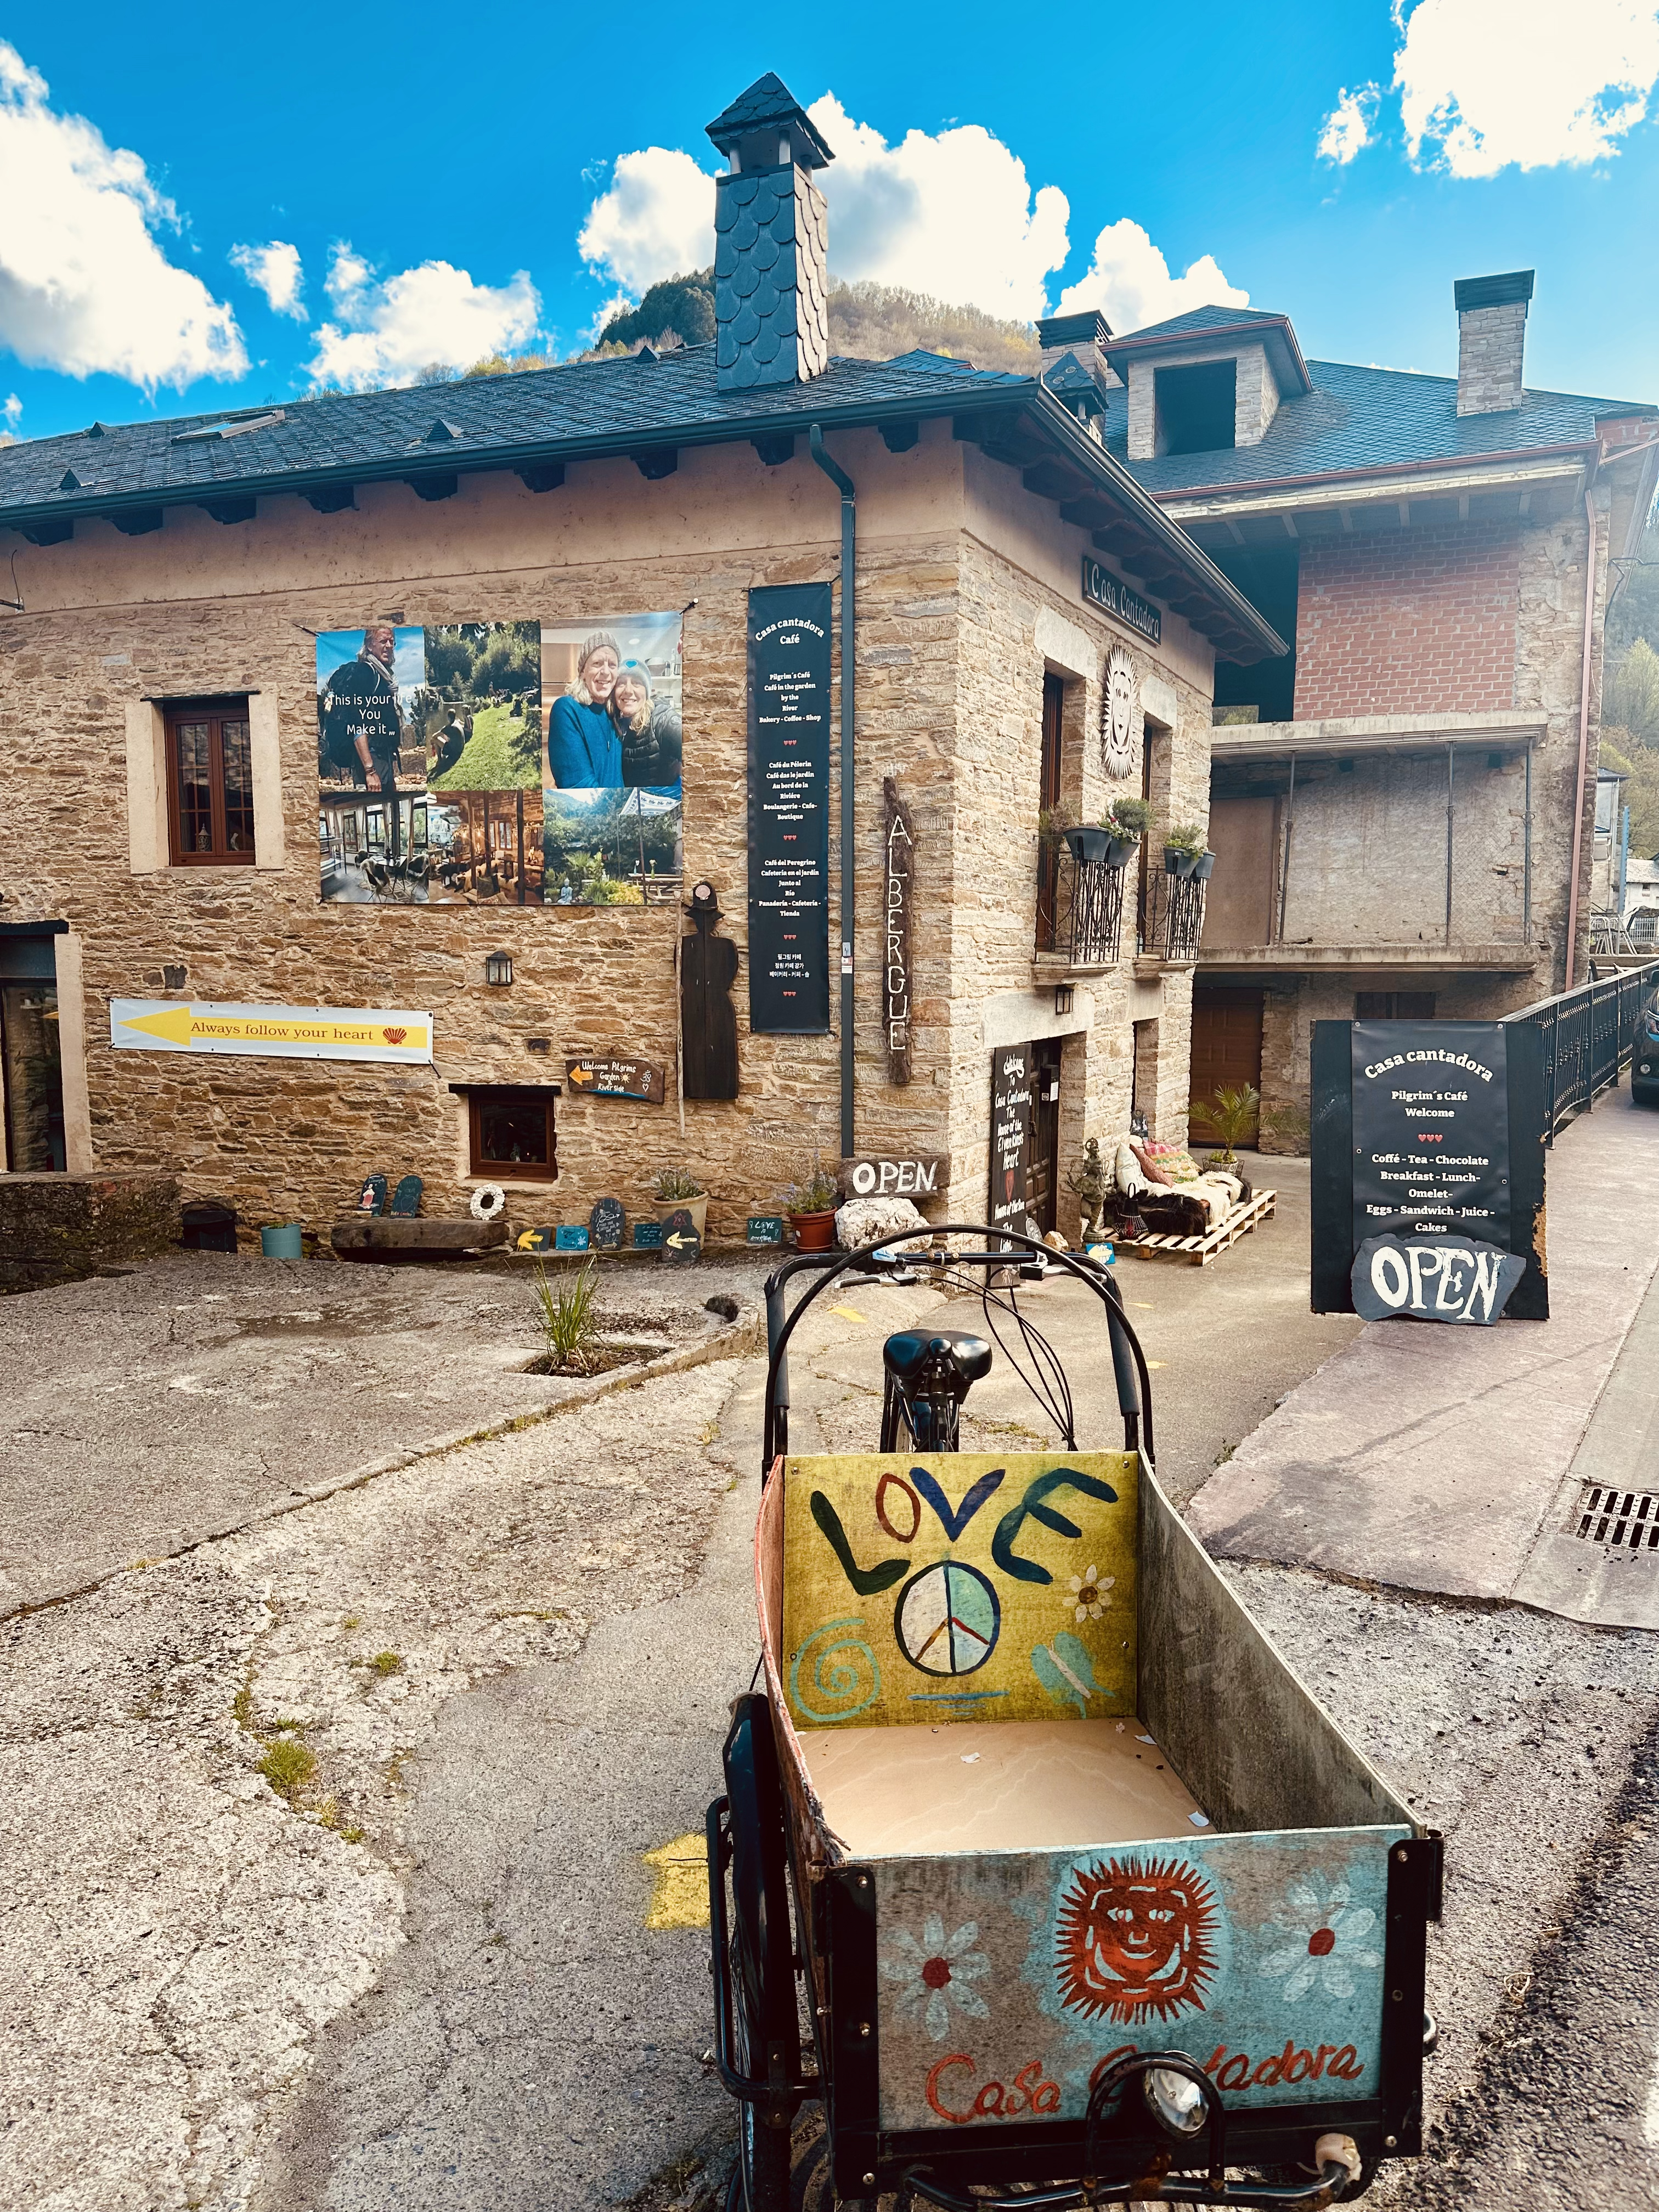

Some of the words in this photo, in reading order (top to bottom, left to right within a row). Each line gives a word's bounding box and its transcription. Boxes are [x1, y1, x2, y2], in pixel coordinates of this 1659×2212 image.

[1092, 563, 1116, 610] Casa
[1120, 585, 1159, 639] Cantadora
[755, 624, 777, 641] Casa
[777, 618, 825, 638] cantadora
[780, 633, 800, 645] Café
[794, 682, 816, 691] garden
[329, 693, 351, 706] This
[353, 693, 363, 706] is
[365, 695, 391, 708] your
[393, 692, 412, 704] life
[781, 694, 789, 702] by
[359, 709, 381, 720] You
[759, 716, 781, 724] Bakery
[805, 714, 821, 722] Shop
[347, 724, 376, 736] Make
[795, 771, 815, 780] jardin
[763, 803, 798, 811] Boulangerie
[777, 813, 804, 821] Boutique
[787, 859, 816, 867] Peregrino
[888, 815, 913, 1051] ALBERGUE
[190, 1022, 240, 1036] Always
[245, 1024, 290, 1036] follow
[293, 1028, 329, 1039] your
[333, 1028, 374, 1040] heart
[1364, 1054, 1406, 1079] Casa
[1406, 1049, 1494, 1082] cantadora
[600, 1071, 620, 1081] Garden
[995, 1092, 1006, 1109] Casa
[1444, 1091, 1468, 1101] Café
[1006, 1105, 1015, 1119] The
[1404, 1107, 1455, 1118] Welcome
[1003, 1147, 1019, 1171] Heart
[1372, 1153, 1400, 1163] Coffé
[1407, 1155, 1428, 1164] Tea
[1435, 1155, 1489, 1165] Chocolate
[1380, 1171, 1434, 1181] Breakfast
[1366, 1204, 1392, 1216] Eggs
[1400, 1205, 1454, 1216] Sandwich
[1460, 1206, 1489, 1218] Juice
[754, 1221, 775, 1229] LOVE
[1415, 1222, 1447, 1232] Cakes
[1370, 1246, 1507, 1321] OPEN
[810, 1466, 1119, 1596] LOVE
[1088, 2039, 1366, 2104] Ctadora
